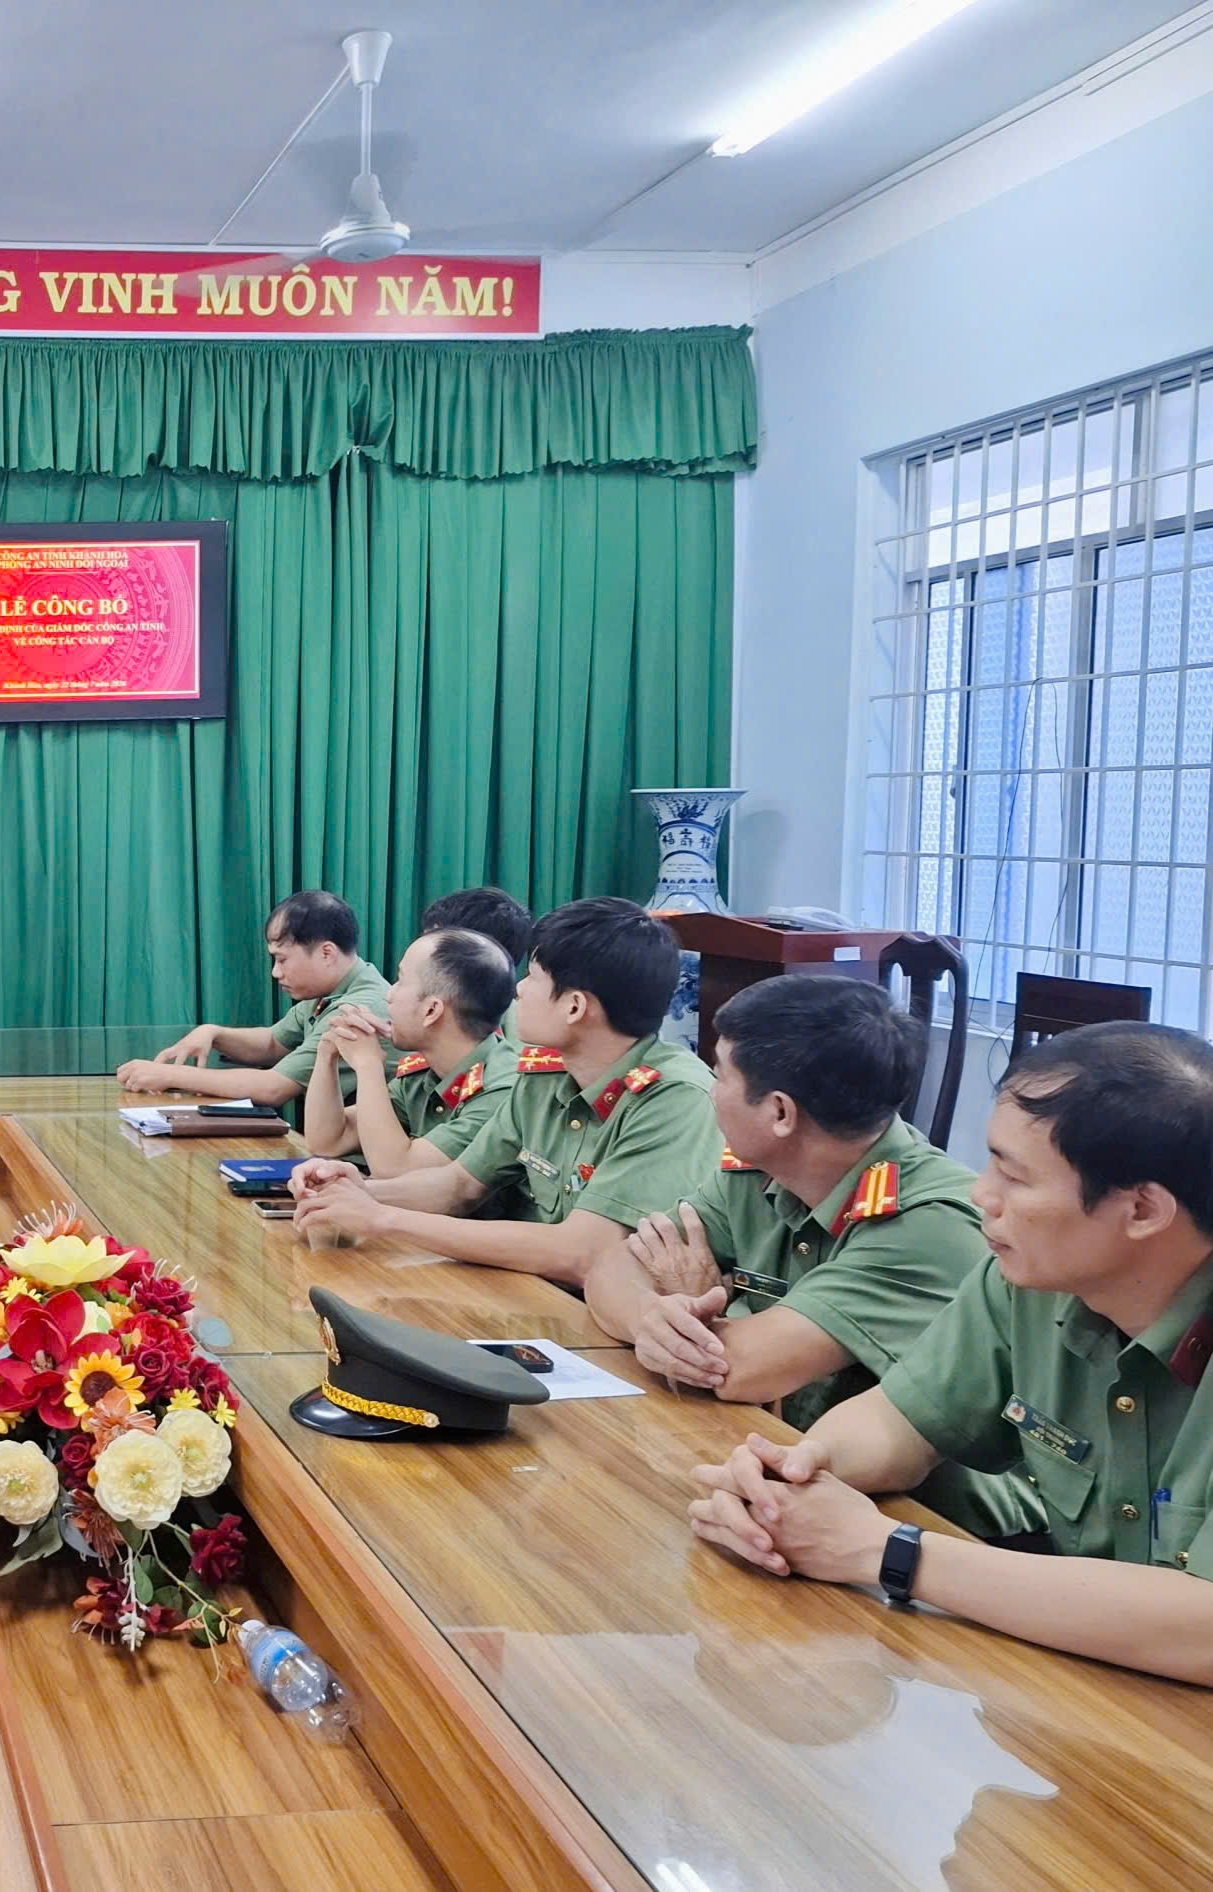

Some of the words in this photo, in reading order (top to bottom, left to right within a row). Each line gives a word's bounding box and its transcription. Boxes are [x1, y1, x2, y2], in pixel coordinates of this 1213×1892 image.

[40, 272, 178, 314] VINH
[197, 265, 358, 316] MUÔN
[376, 265, 513, 317] NĂM!
[26, 551, 41, 560] AN
[33, 560, 48, 569] AN
[49, 560, 75, 569] NINH
[0, 595, 27, 617] LỄ
[32, 594, 94, 616] CÔNG
[98, 593, 129, 615] BỐ
[95, 621, 124, 632] CÔNG
[126, 623, 138, 632] AN
[28, 635, 57, 646] CÔNG
